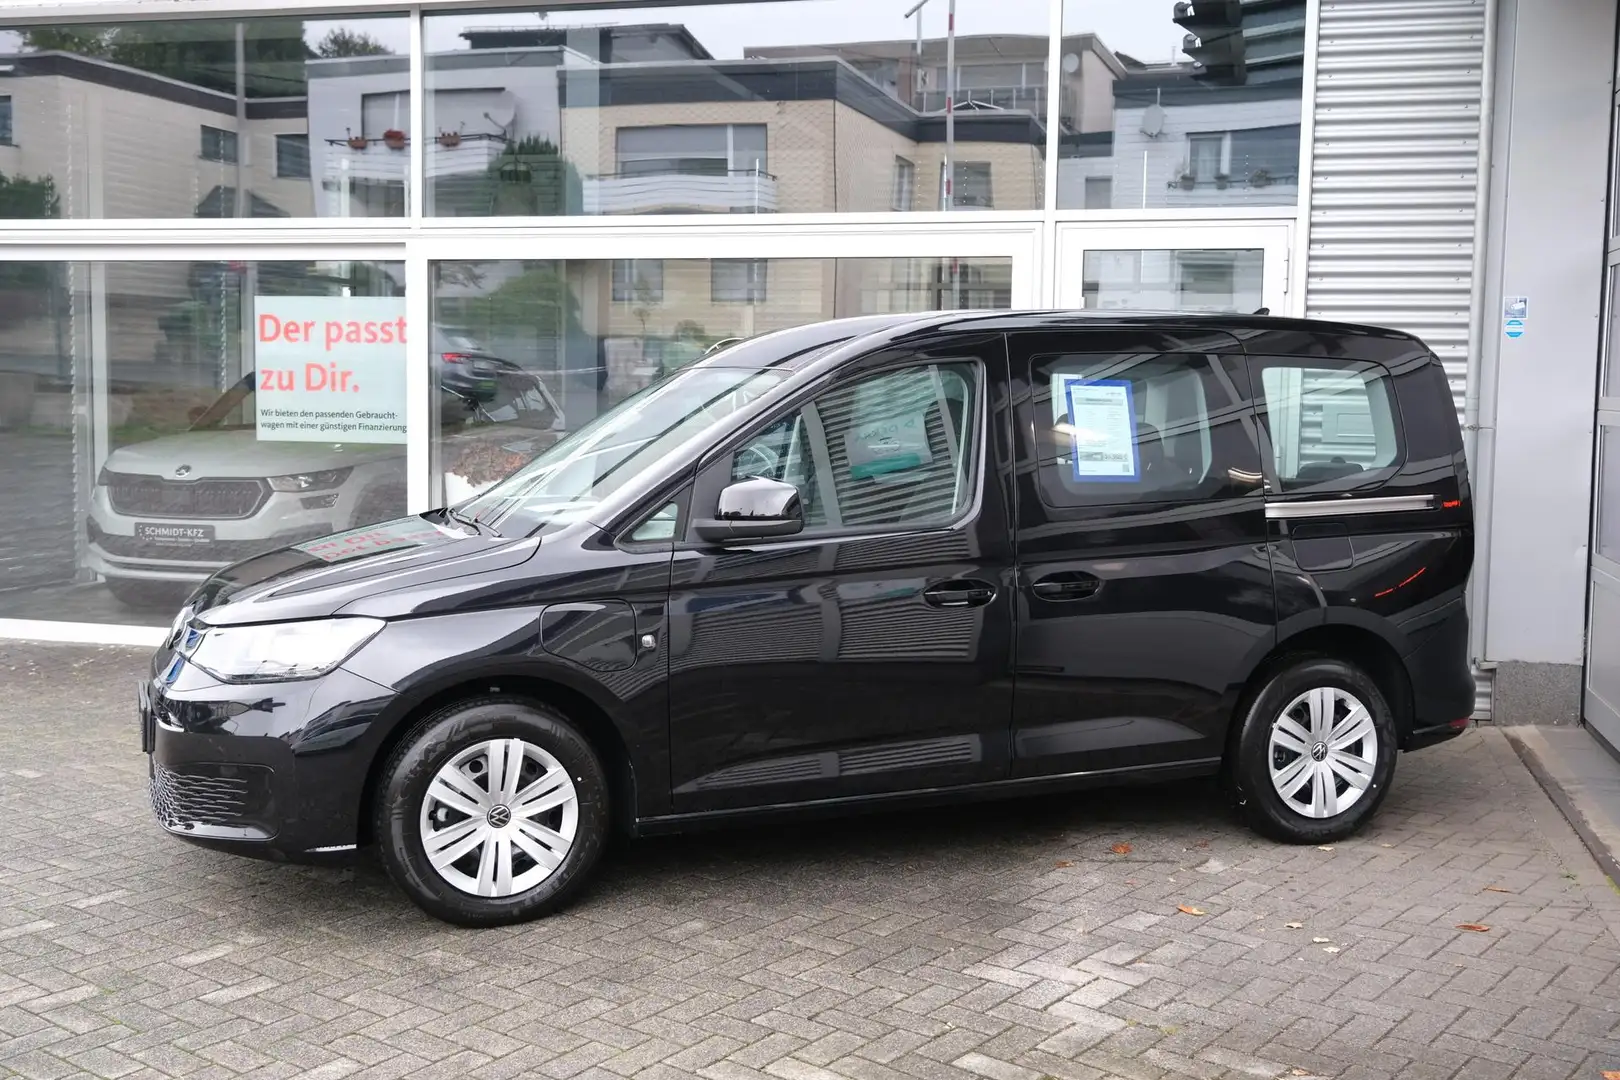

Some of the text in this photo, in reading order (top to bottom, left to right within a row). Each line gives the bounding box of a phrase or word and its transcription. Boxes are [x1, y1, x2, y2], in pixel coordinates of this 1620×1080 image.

[259, 313, 407, 351] Der passt
[260, 362, 360, 392] zu Dir.
[261, 409, 398, 421] Wir bieten den passenden Gebraucht-
[261, 421, 407, 433] wagen mit einer günstigen Finanzierung
[144, 526, 204, 537] SCHMIDT-KFZ
